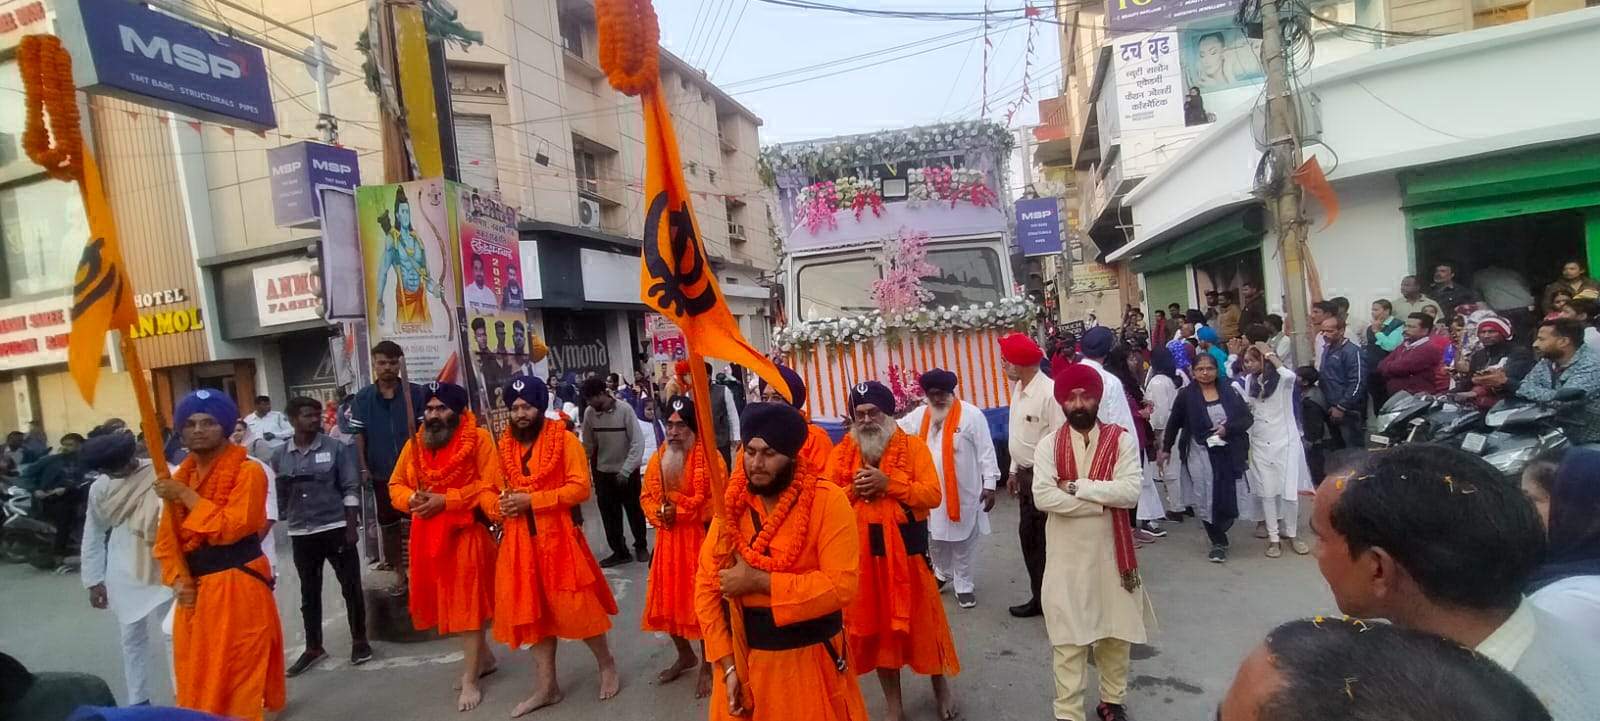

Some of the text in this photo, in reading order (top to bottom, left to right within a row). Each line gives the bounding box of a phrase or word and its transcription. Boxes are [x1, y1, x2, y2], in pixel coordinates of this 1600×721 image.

[118, 23, 241, 79] MSP
[1120, 36, 1170, 63] टच वुड
[129, 72, 260, 114] TMT BARS STRUCTURALS PIPES
[272, 161, 302, 176] MSP
[312, 159, 352, 174] MSP
[1021, 210, 1052, 221] MSP
[134, 287, 184, 308] HOTEL
